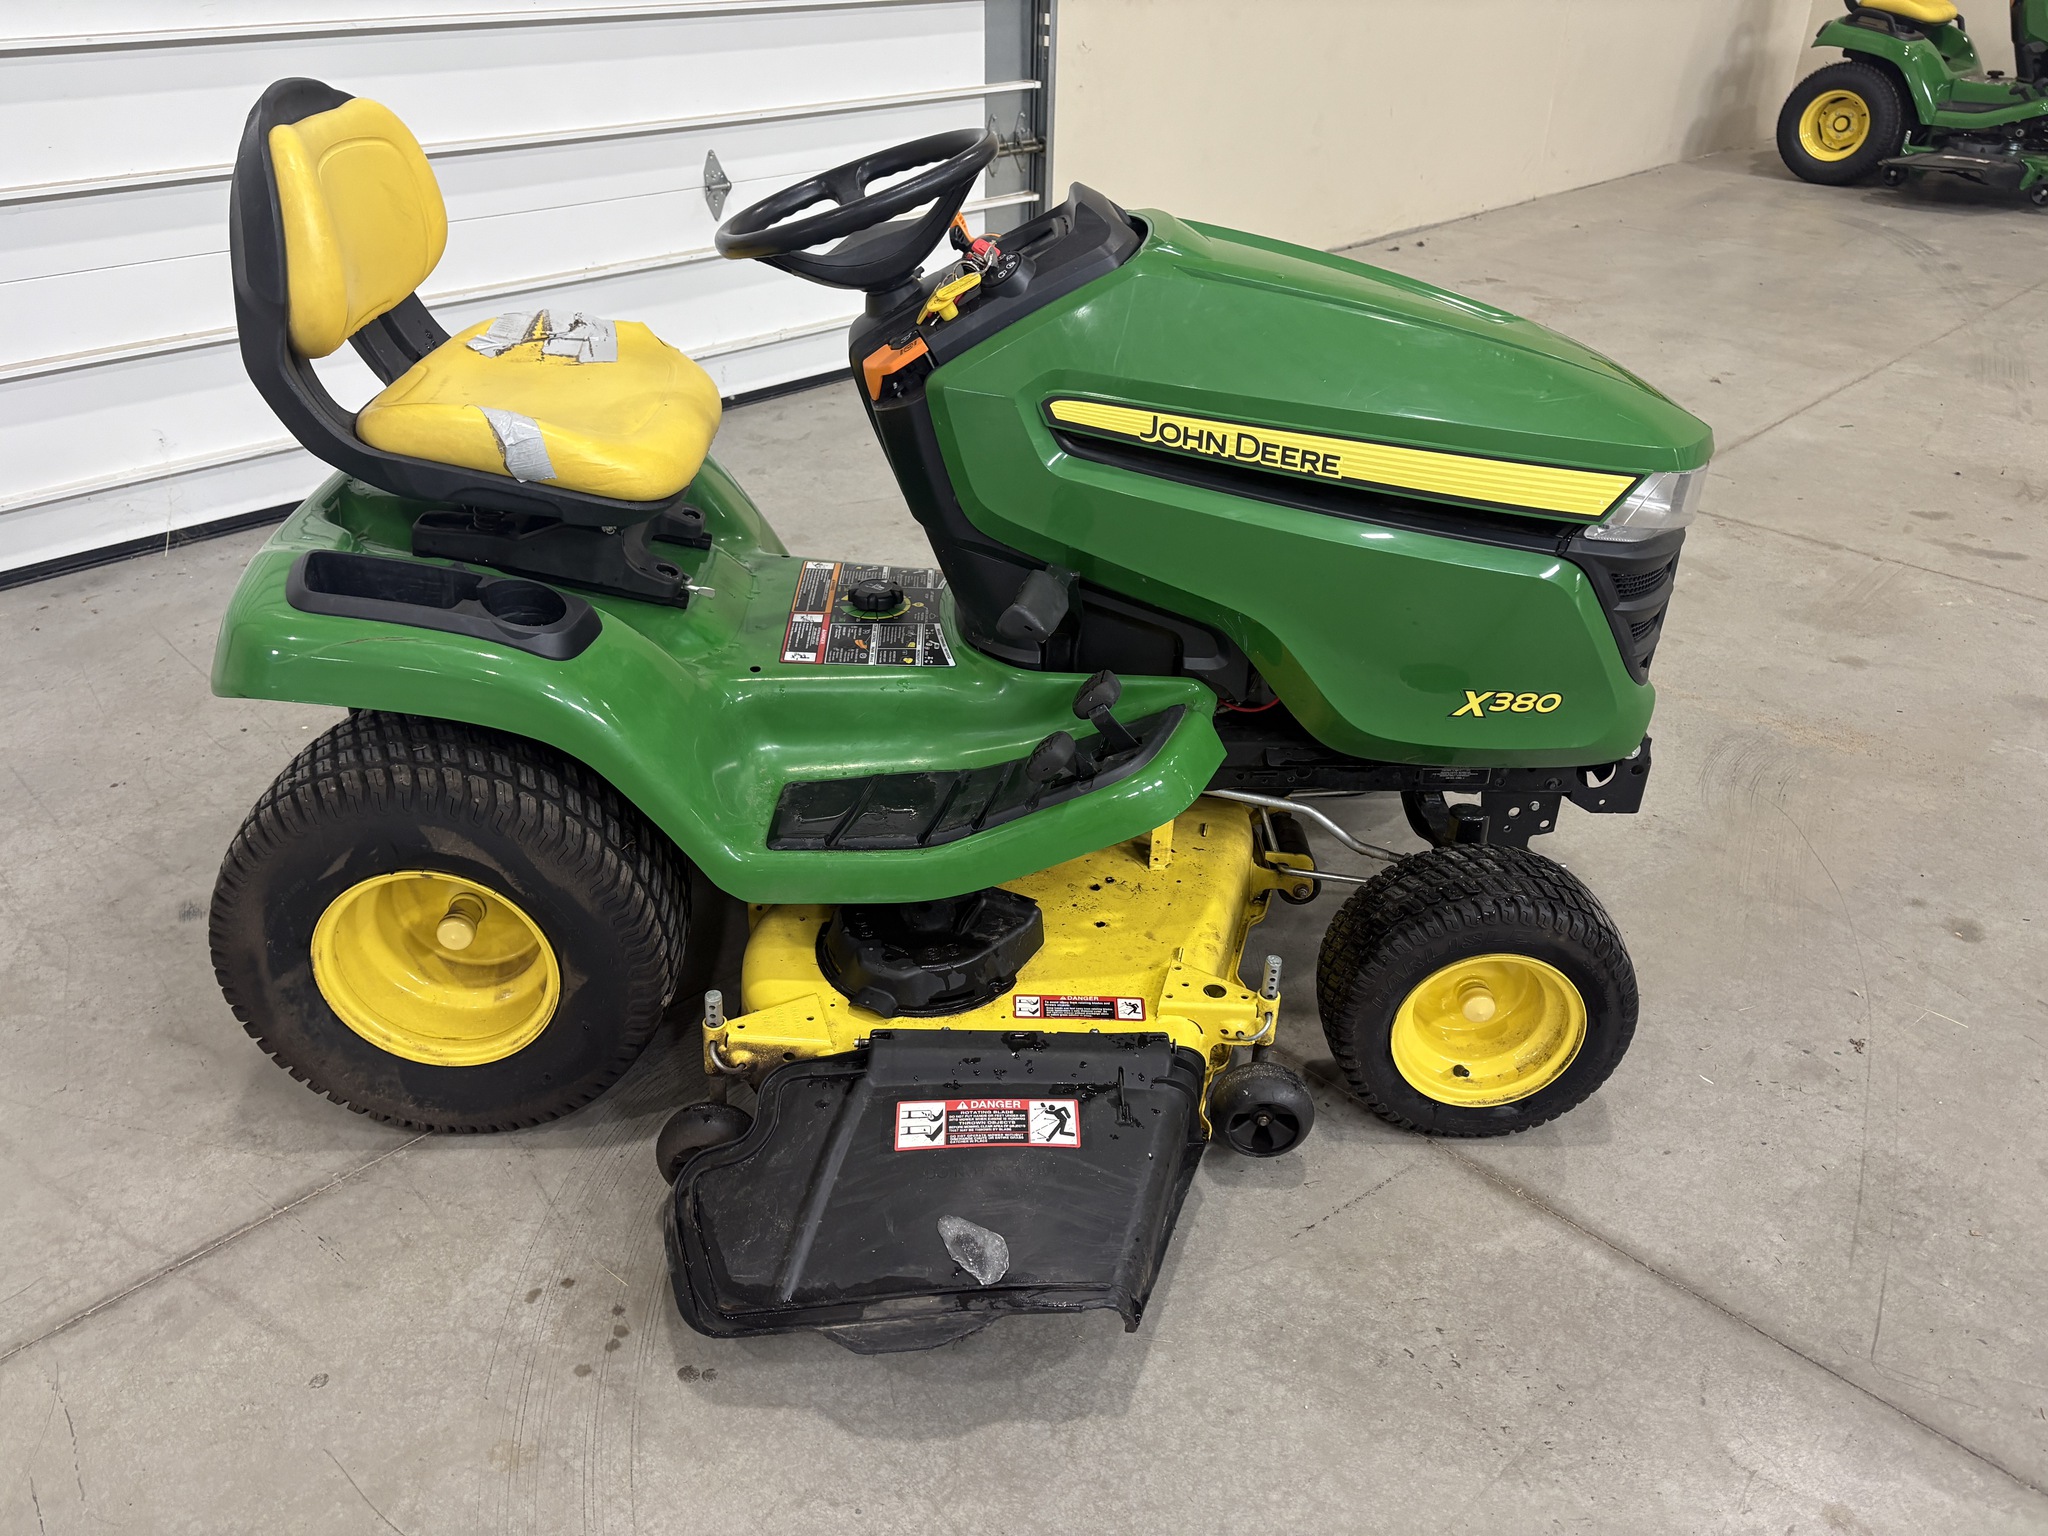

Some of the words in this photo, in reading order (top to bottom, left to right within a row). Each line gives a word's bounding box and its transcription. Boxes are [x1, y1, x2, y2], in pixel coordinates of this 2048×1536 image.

[1140, 415, 1227, 454] JOHN
[1235, 432, 1341, 476] DEERE
[1449, 690, 1563, 717] X380
[971, 1100, 1021, 1108] DANGER
